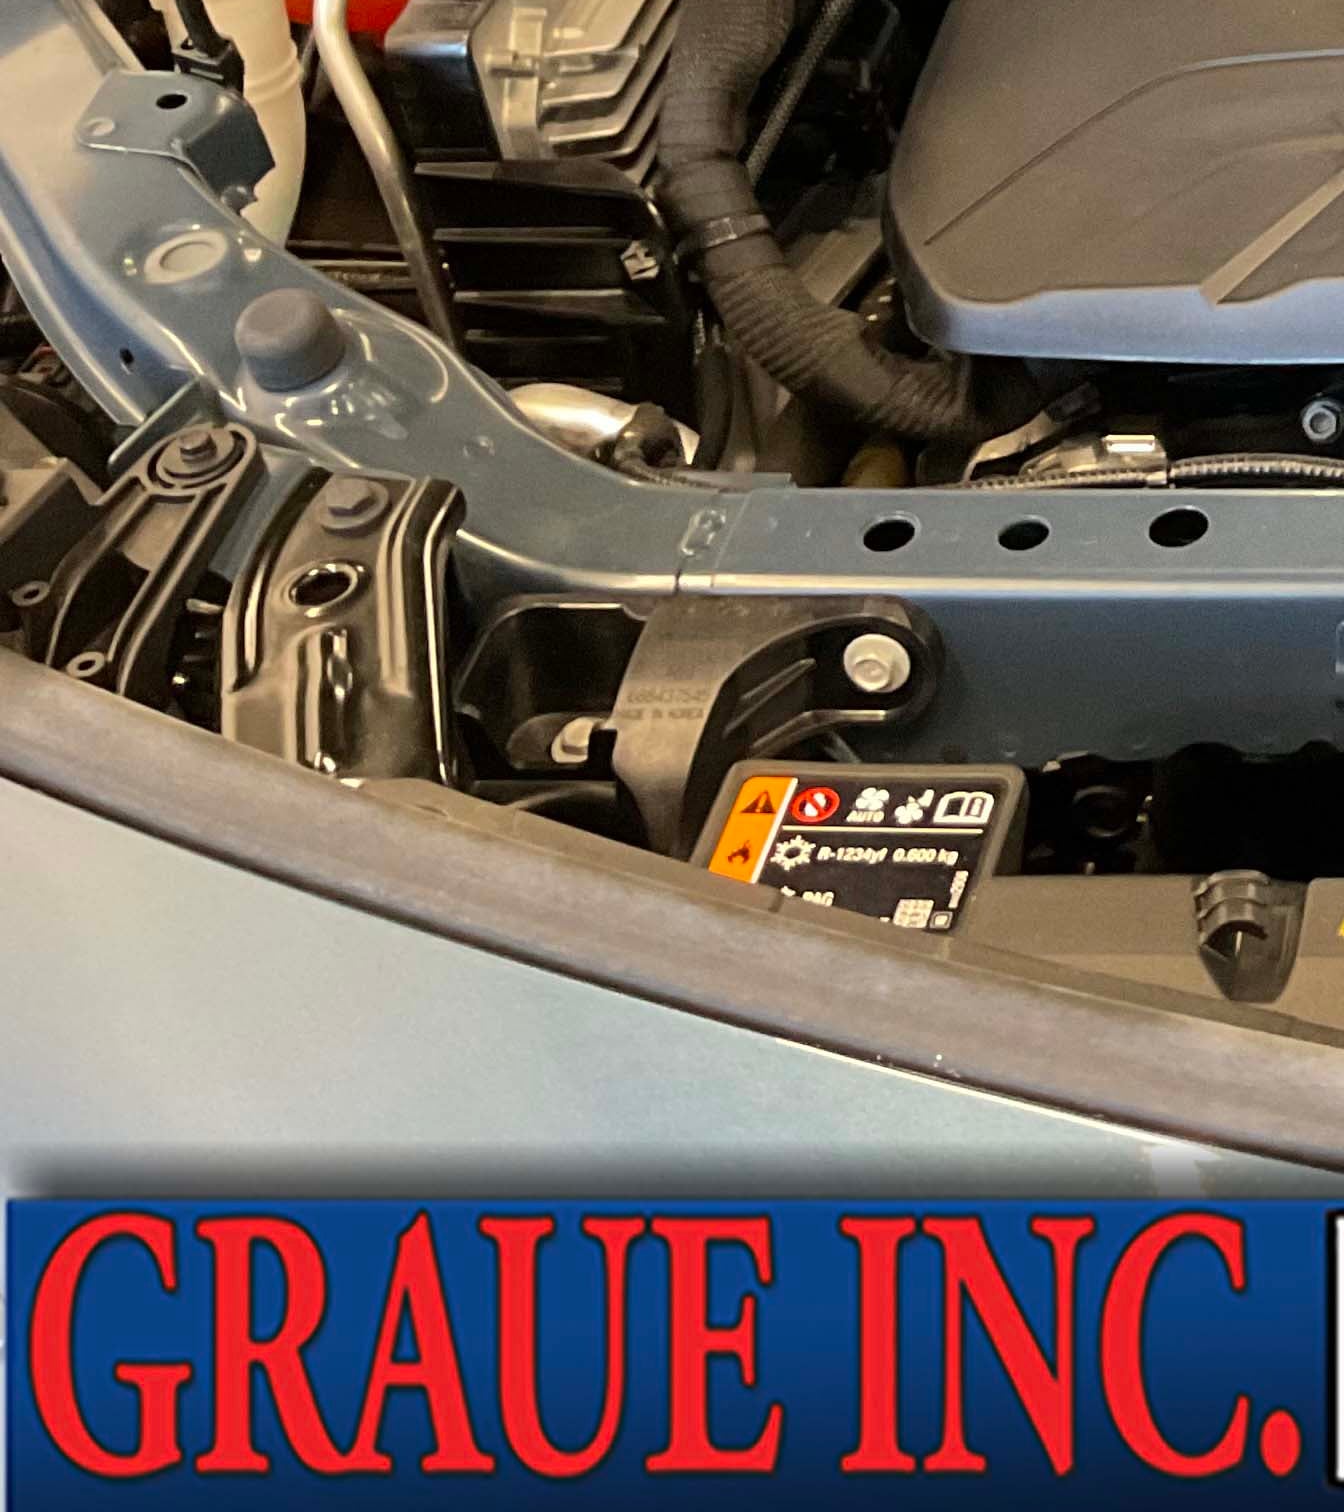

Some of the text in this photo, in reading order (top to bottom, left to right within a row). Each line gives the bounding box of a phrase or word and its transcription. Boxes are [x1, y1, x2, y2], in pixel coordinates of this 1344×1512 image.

[846, 810, 885, 823] AUTO
[816, 846, 888, 864] R-1234yf
[937, 848, 959, 866] kg
